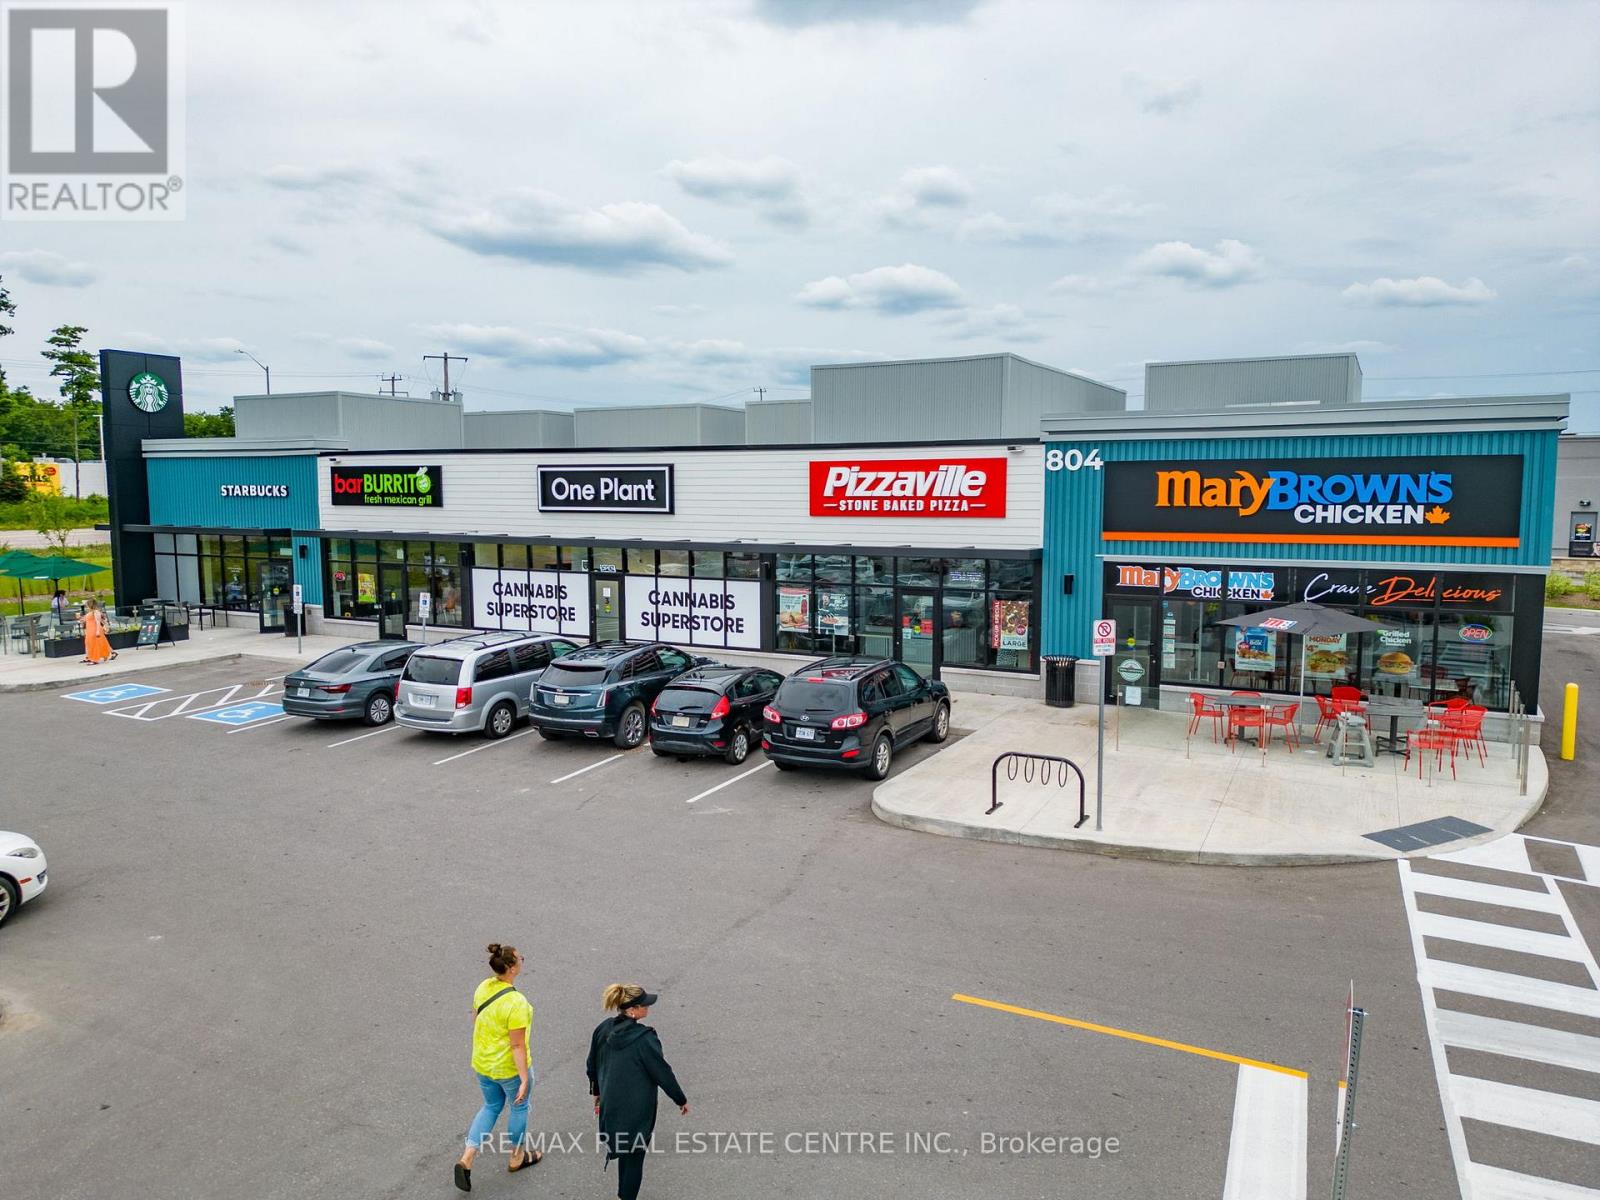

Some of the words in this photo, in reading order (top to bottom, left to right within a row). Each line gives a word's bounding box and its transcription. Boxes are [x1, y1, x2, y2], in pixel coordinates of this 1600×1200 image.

[1046, 449, 1104, 471] 804
[551, 477, 596, 500] One
[600, 477, 656, 501] Plant
[823, 465, 987, 497] Pizzaville
[221, 485, 288, 497] STARBUCKS
[364, 494, 383, 504] fresh
[384, 494, 417, 505] mexican
[418, 495, 432, 507] grill
[839, 500, 878, 511] STONE
[883, 500, 924, 511] BAKED
[930, 500, 969, 512] PIZZA
[1294, 504, 1425, 524] CHICKEN
[493, 582, 568, 600] CANNABIS
[648, 590, 736, 610] CANNABIS
[1191, 586, 1260, 599] CHICKEN
[486, 602, 576, 622] SUPERSTORE
[641, 611, 744, 633] SUPERSTORE
[1462, 628, 1489, 639] OPEN
[1002, 640, 1027, 648] LARGE
